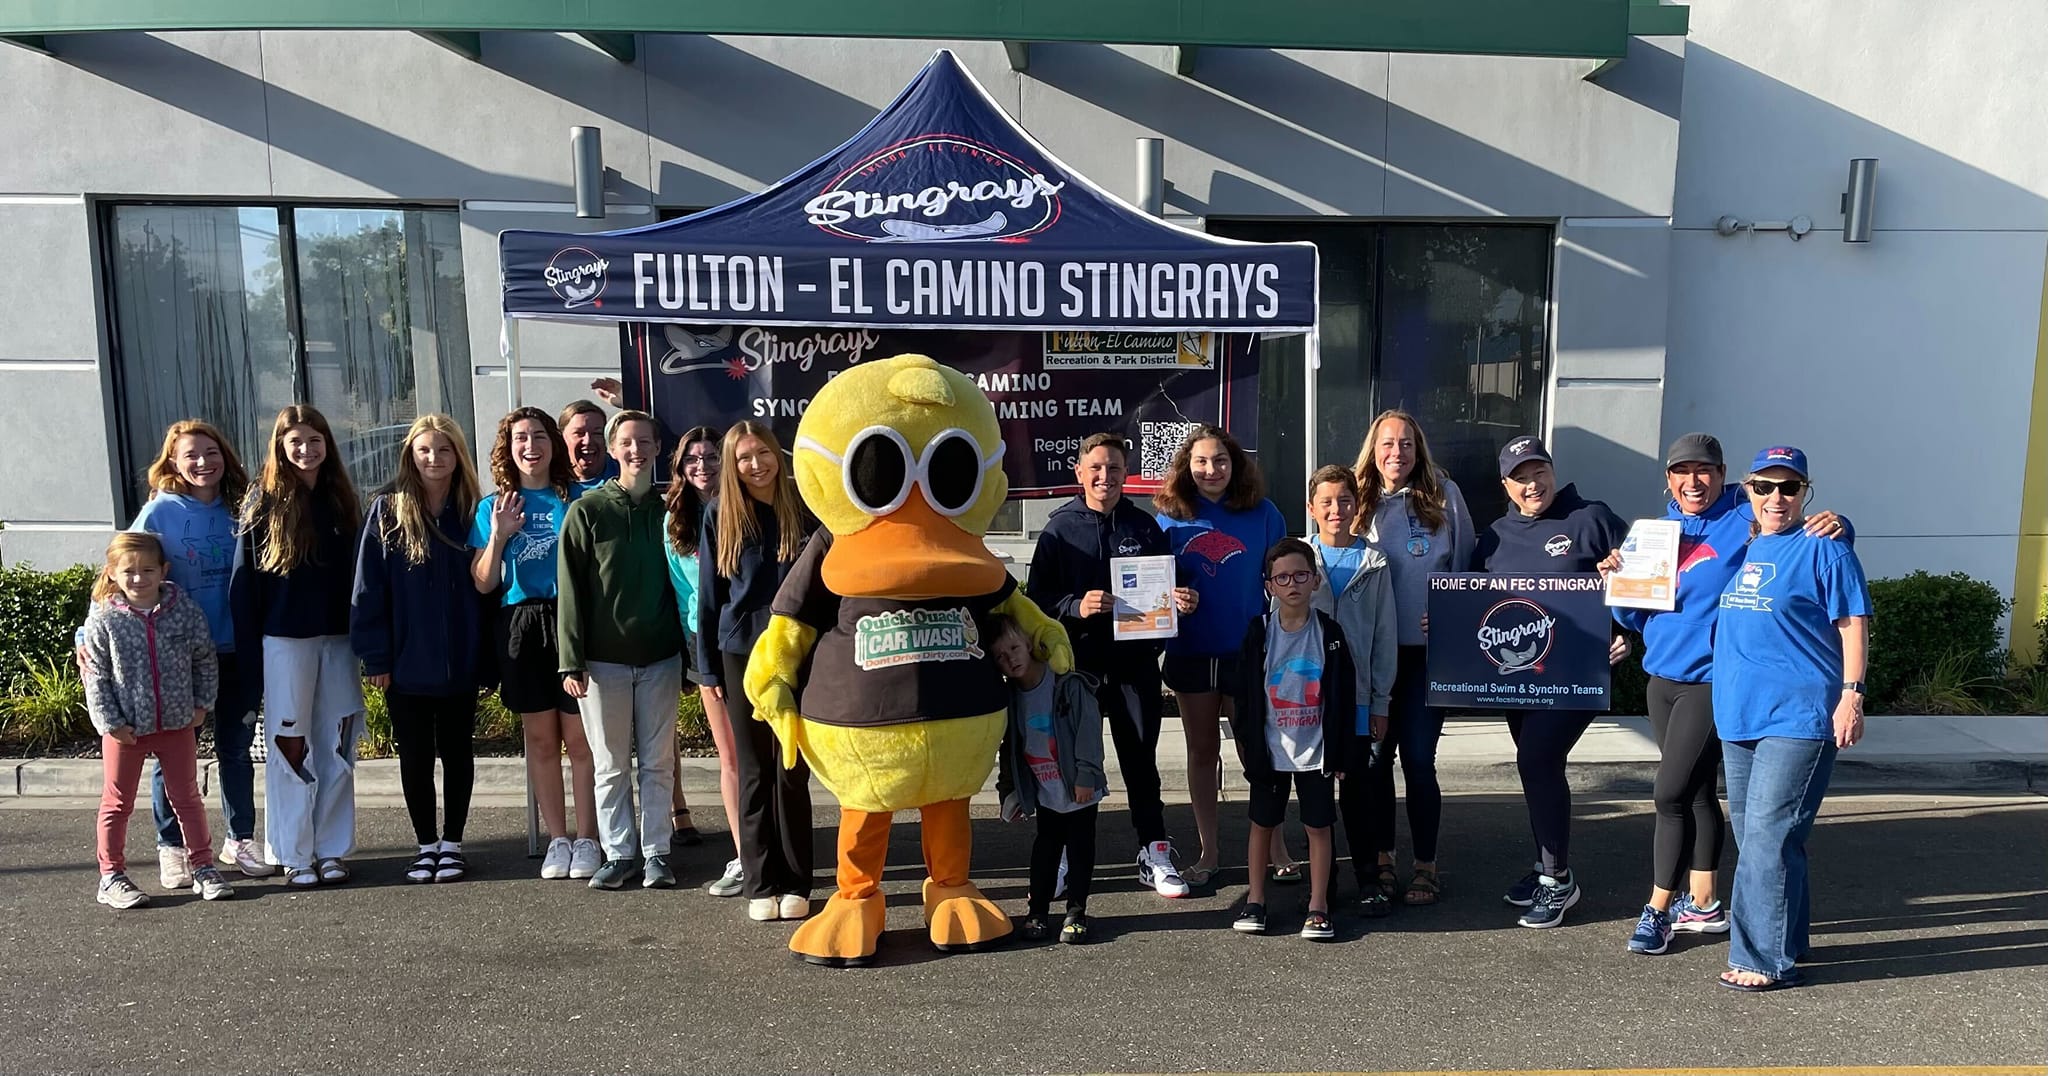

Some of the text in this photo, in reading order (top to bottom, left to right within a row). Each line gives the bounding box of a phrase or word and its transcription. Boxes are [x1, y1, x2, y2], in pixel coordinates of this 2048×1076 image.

[804, 174, 1065, 225] Stingrays
[543, 258, 610, 288] Stingrays
[633, 252, 785, 312] FULTON
[829, 257, 873, 314] EL
[886, 258, 1045, 317] CAMINO
[1060, 262, 1279, 319] STINGRAYS
[738, 326, 880, 372] Stingrays
[1123, 332, 1173, 349] Camino
[1046, 355, 1177, 365] Recreation & Park District
[1065, 399, 1123, 416] TEAM
[1048, 459, 1062, 471] in
[532, 513, 554, 521] FEC
[1431, 578, 1466, 590] HOME
[1469, 578, 1487, 590] OF
[1489, 578, 1507, 590] AN
[1510, 578, 1535, 590] FEC
[860, 610, 962, 632] Quick Quack
[868, 628, 963, 654] CAR WASH
[1477, 615, 1556, 651] Stingrays
[1430, 681, 1604, 696] Recreational Swim & Synchro Teams
